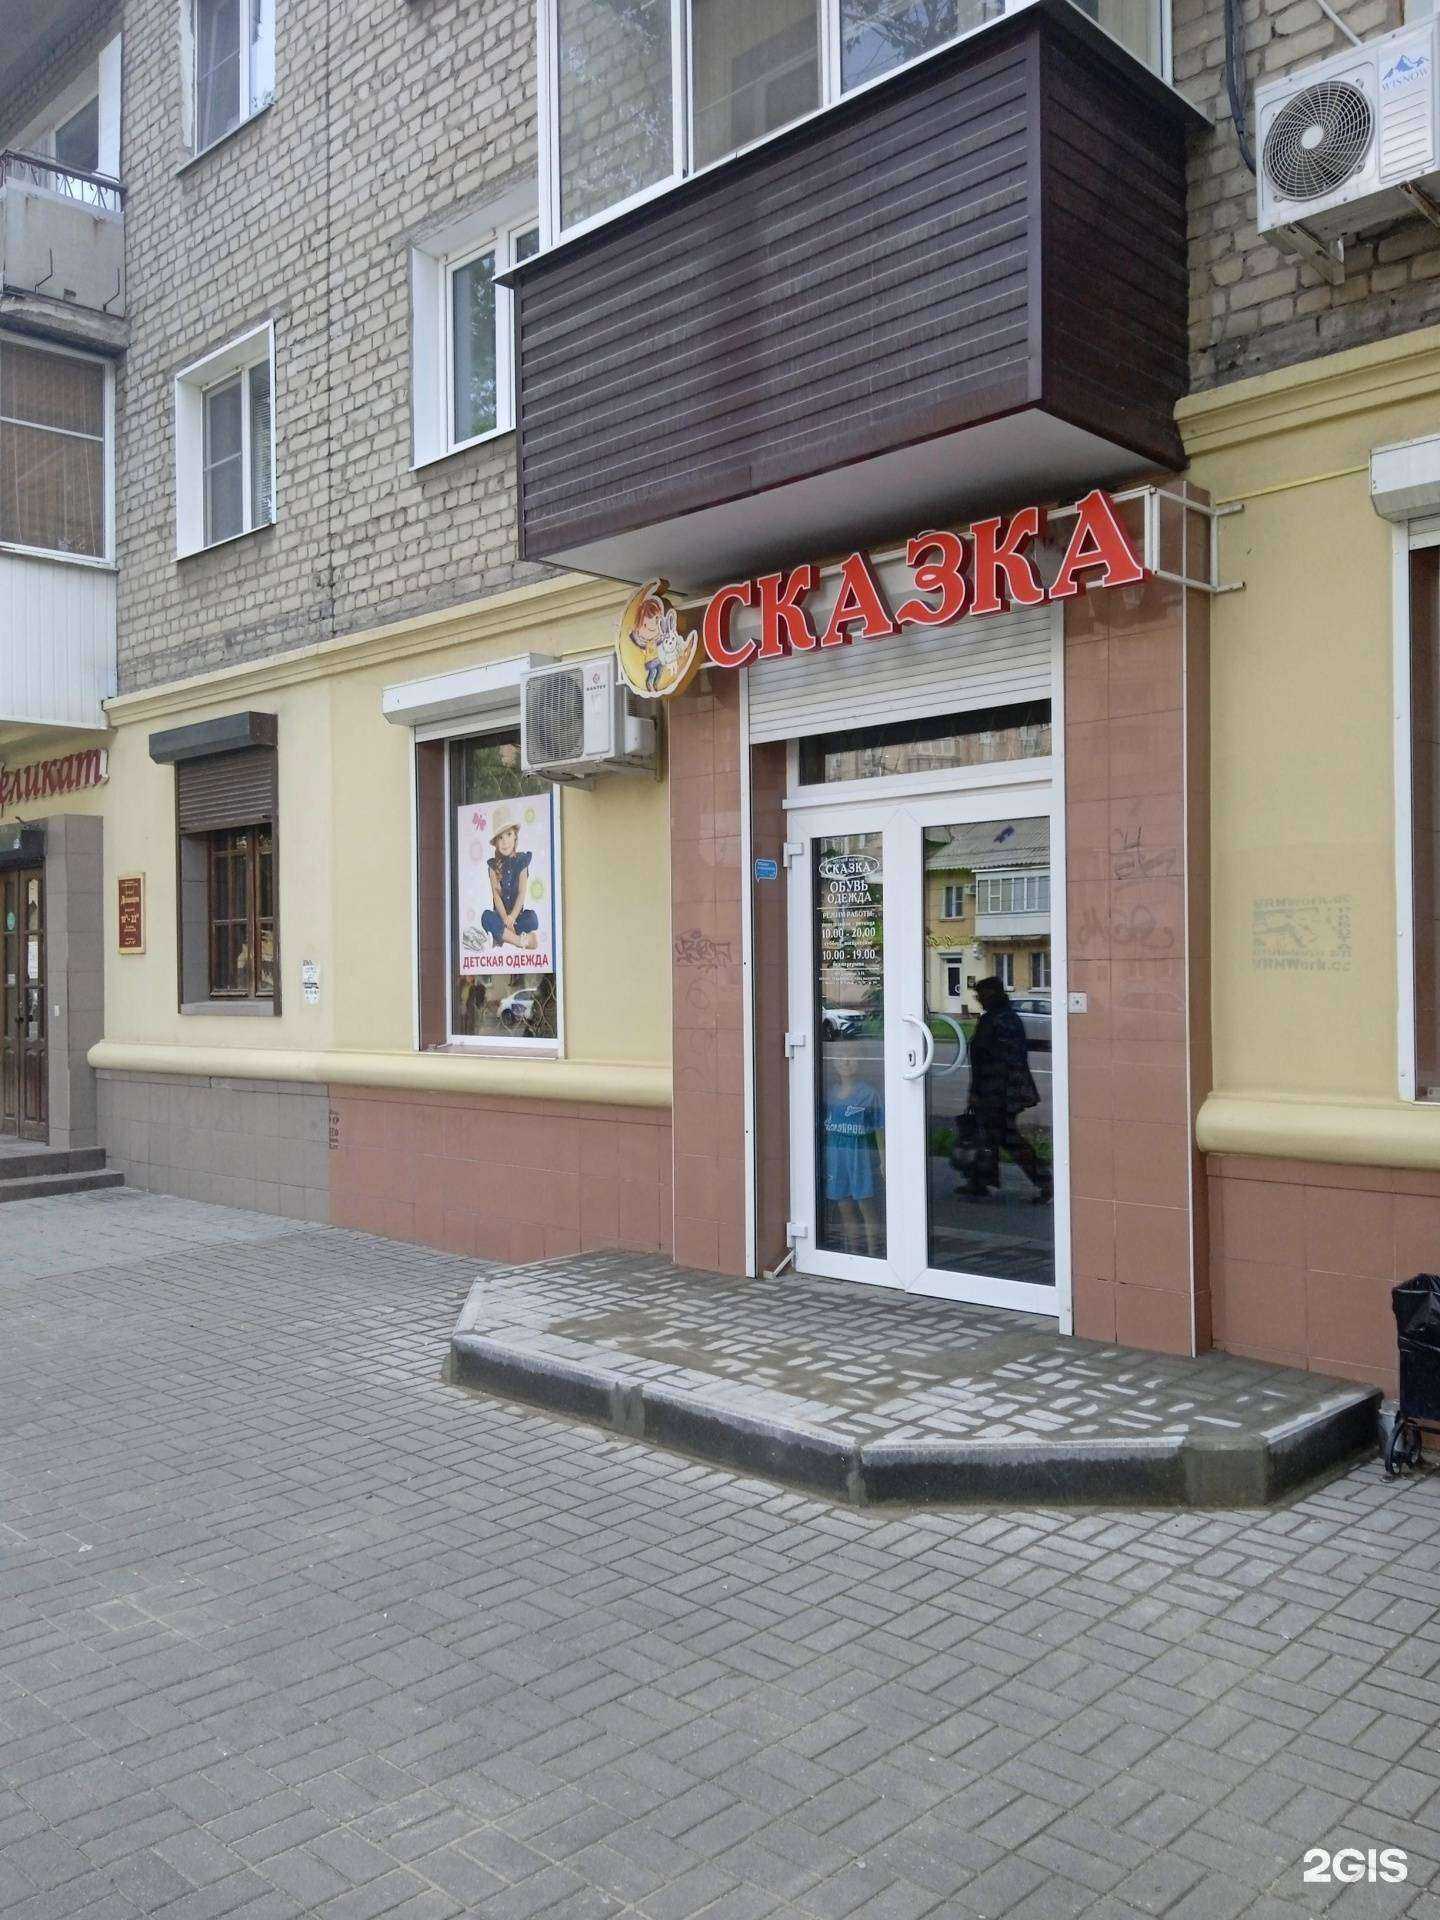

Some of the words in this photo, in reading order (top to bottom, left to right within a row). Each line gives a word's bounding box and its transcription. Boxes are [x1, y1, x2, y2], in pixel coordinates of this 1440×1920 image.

[702, 489, 1146, 669] СКАЗКА
[0, 747, 103, 806] еликат
[825, 862, 871, 875] СКАЗКА
[830, 880, 868, 893] ОБУВЬ
[828, 892, 872, 904] ОДЕЖДА
[822, 927, 844, 939] 10.00
[851, 927, 876, 938] 20.00
[822, 950, 845, 960] 10.00
[852, 949, 876, 959] 19.00
[463, 956, 504, 969] ДЕТСКАЯ
[506, 954, 549, 968] ОДЕЖДА
